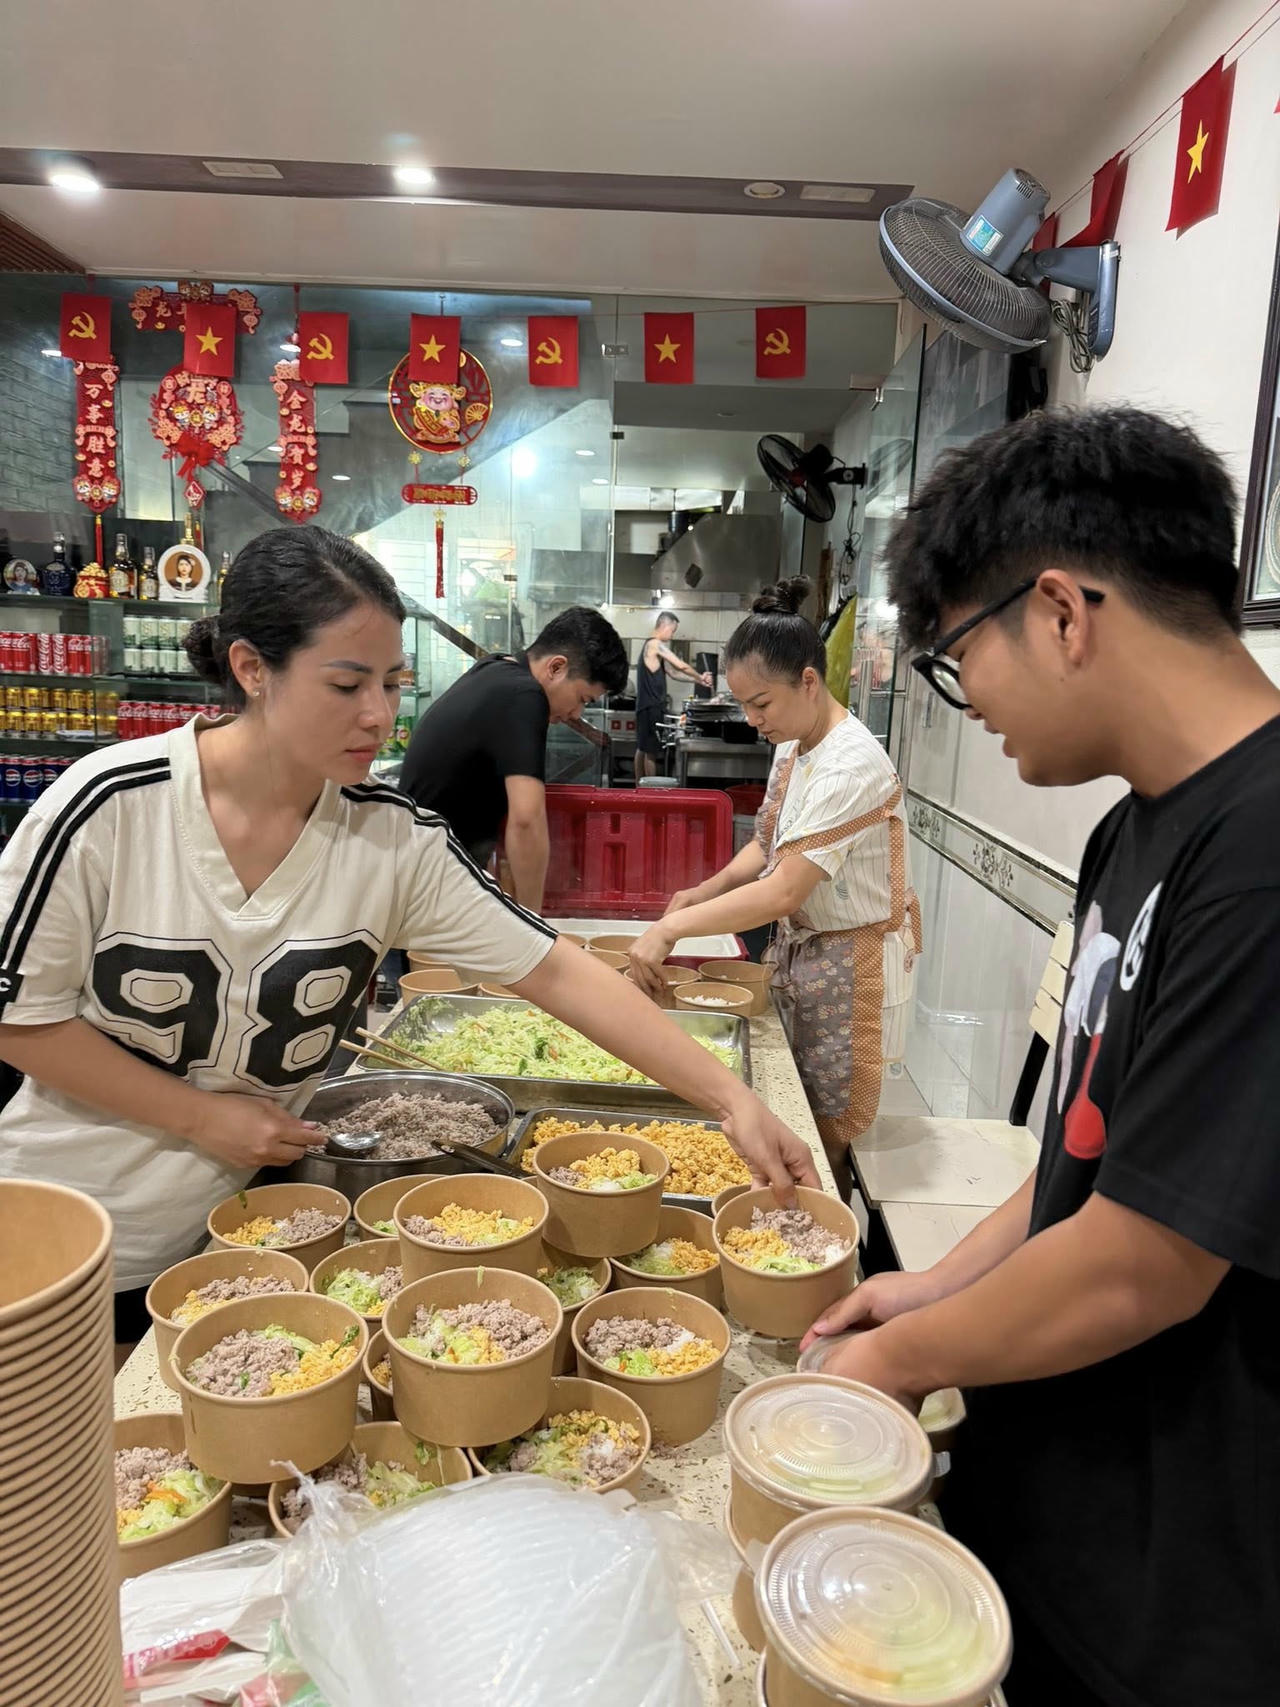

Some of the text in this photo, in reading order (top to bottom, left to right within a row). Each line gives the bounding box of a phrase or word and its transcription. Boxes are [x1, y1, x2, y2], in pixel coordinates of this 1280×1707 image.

[84, 383, 106, 478] 万事胜意
[287, 389, 307, 490] 金龙贺岁
[92, 929, 382, 1093] 98
